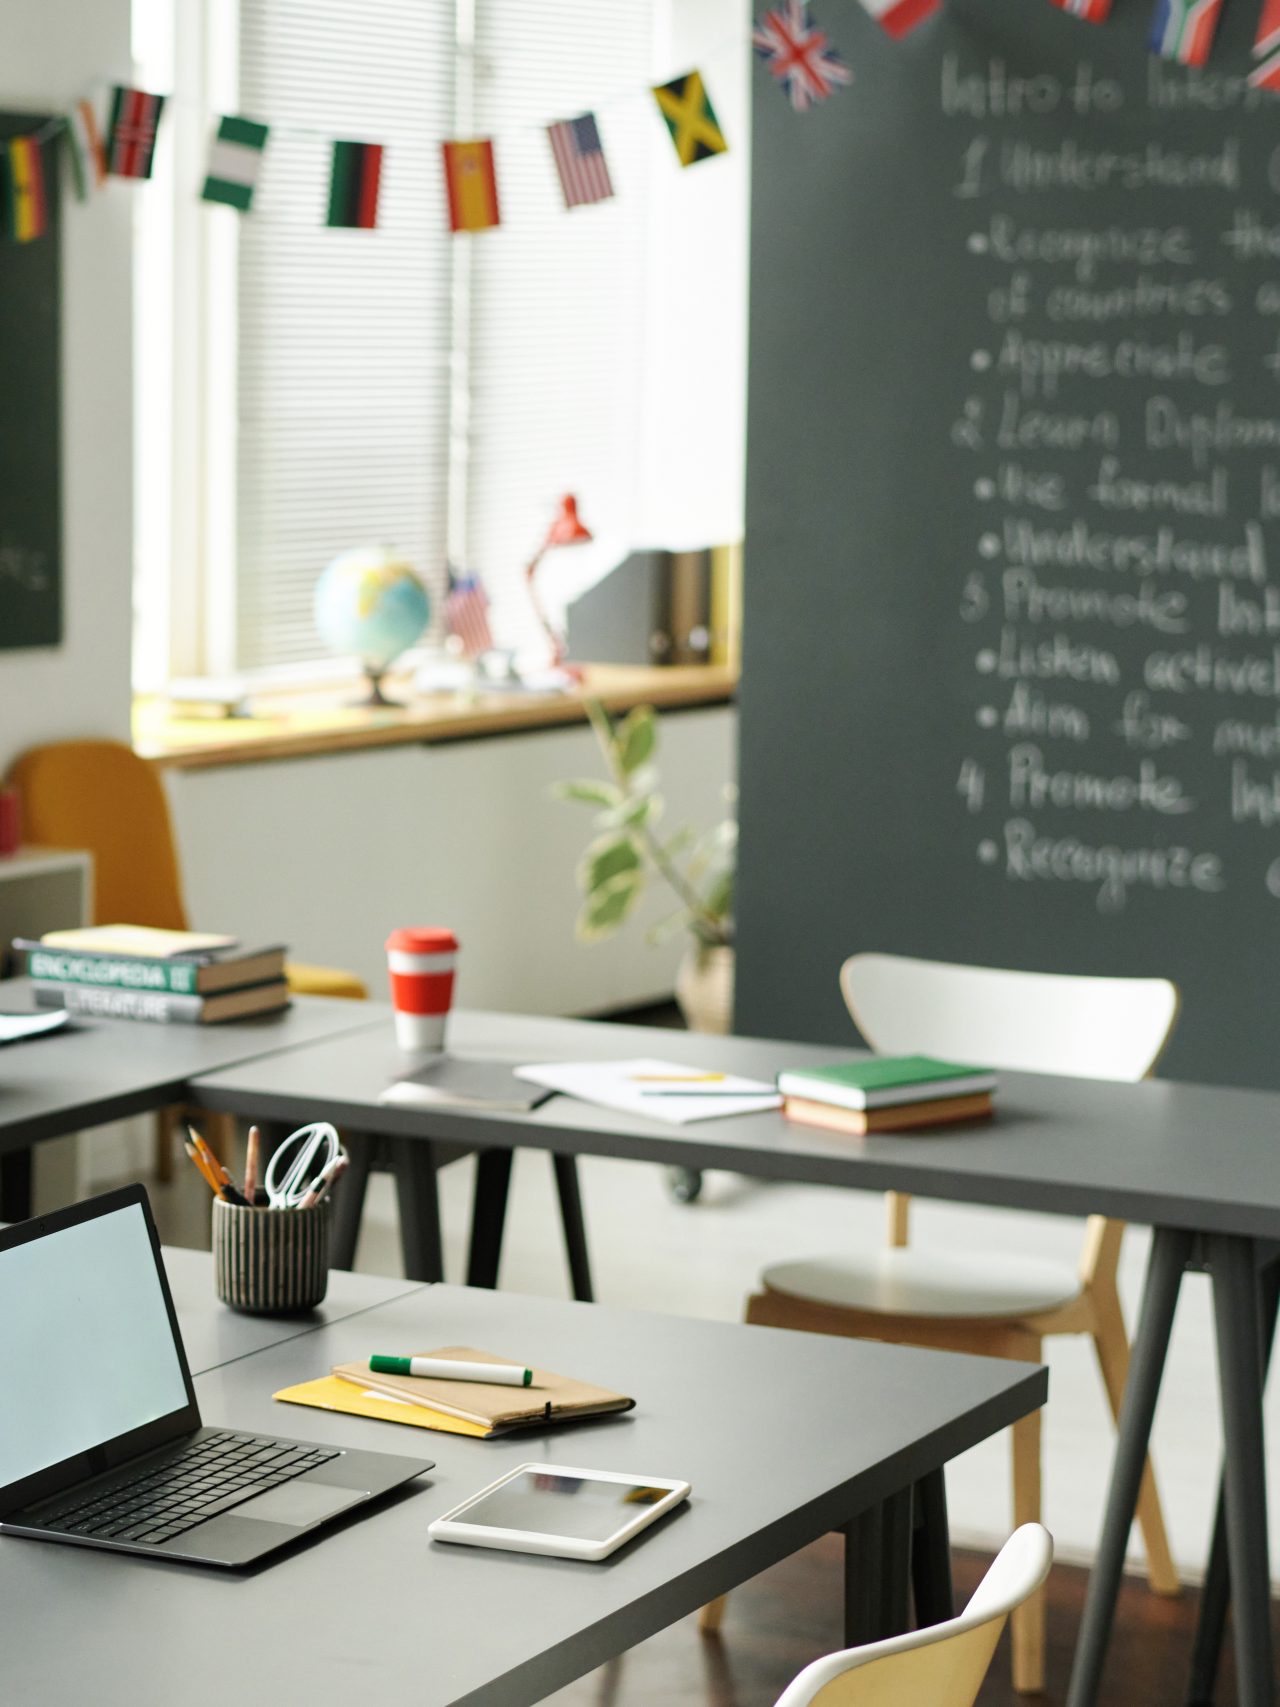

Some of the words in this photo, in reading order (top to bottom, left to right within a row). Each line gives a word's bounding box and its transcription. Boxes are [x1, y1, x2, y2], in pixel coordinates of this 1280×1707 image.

[1071, 58, 1120, 114] to
[1002, 516, 1267, 584] Understand
[1002, 565, 1190, 634] Promote
[998, 623, 1120, 685] Listen
[1003, 681, 1090, 741] Aim
[1009, 741, 1195, 814] Promote
[1004, 818, 1223, 915] Recognize
[31, 953, 166, 988] ENCYCLOPEDIA
